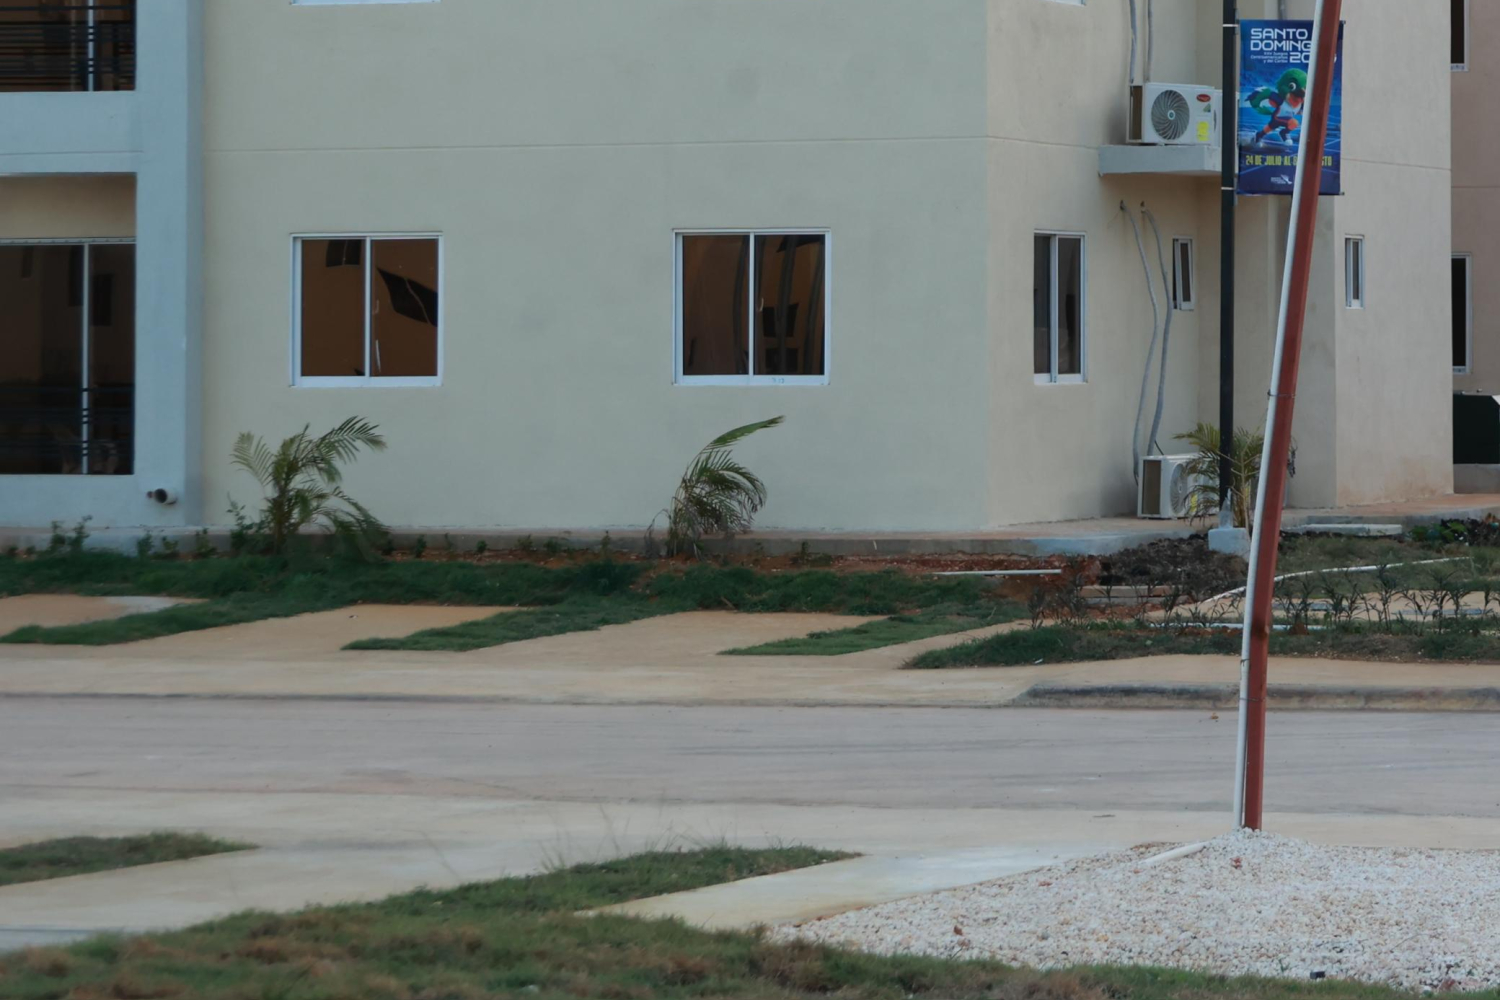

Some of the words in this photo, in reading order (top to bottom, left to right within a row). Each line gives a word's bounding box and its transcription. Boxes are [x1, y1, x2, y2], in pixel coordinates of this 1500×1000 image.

[1250, 28, 1308, 40] SANTO
[1250, 40, 1312, 51] DOMING
[1245, 155, 1254, 166] 24
[1255, 155, 1262, 166] DE
[1265, 155, 1282, 166] JULIO
